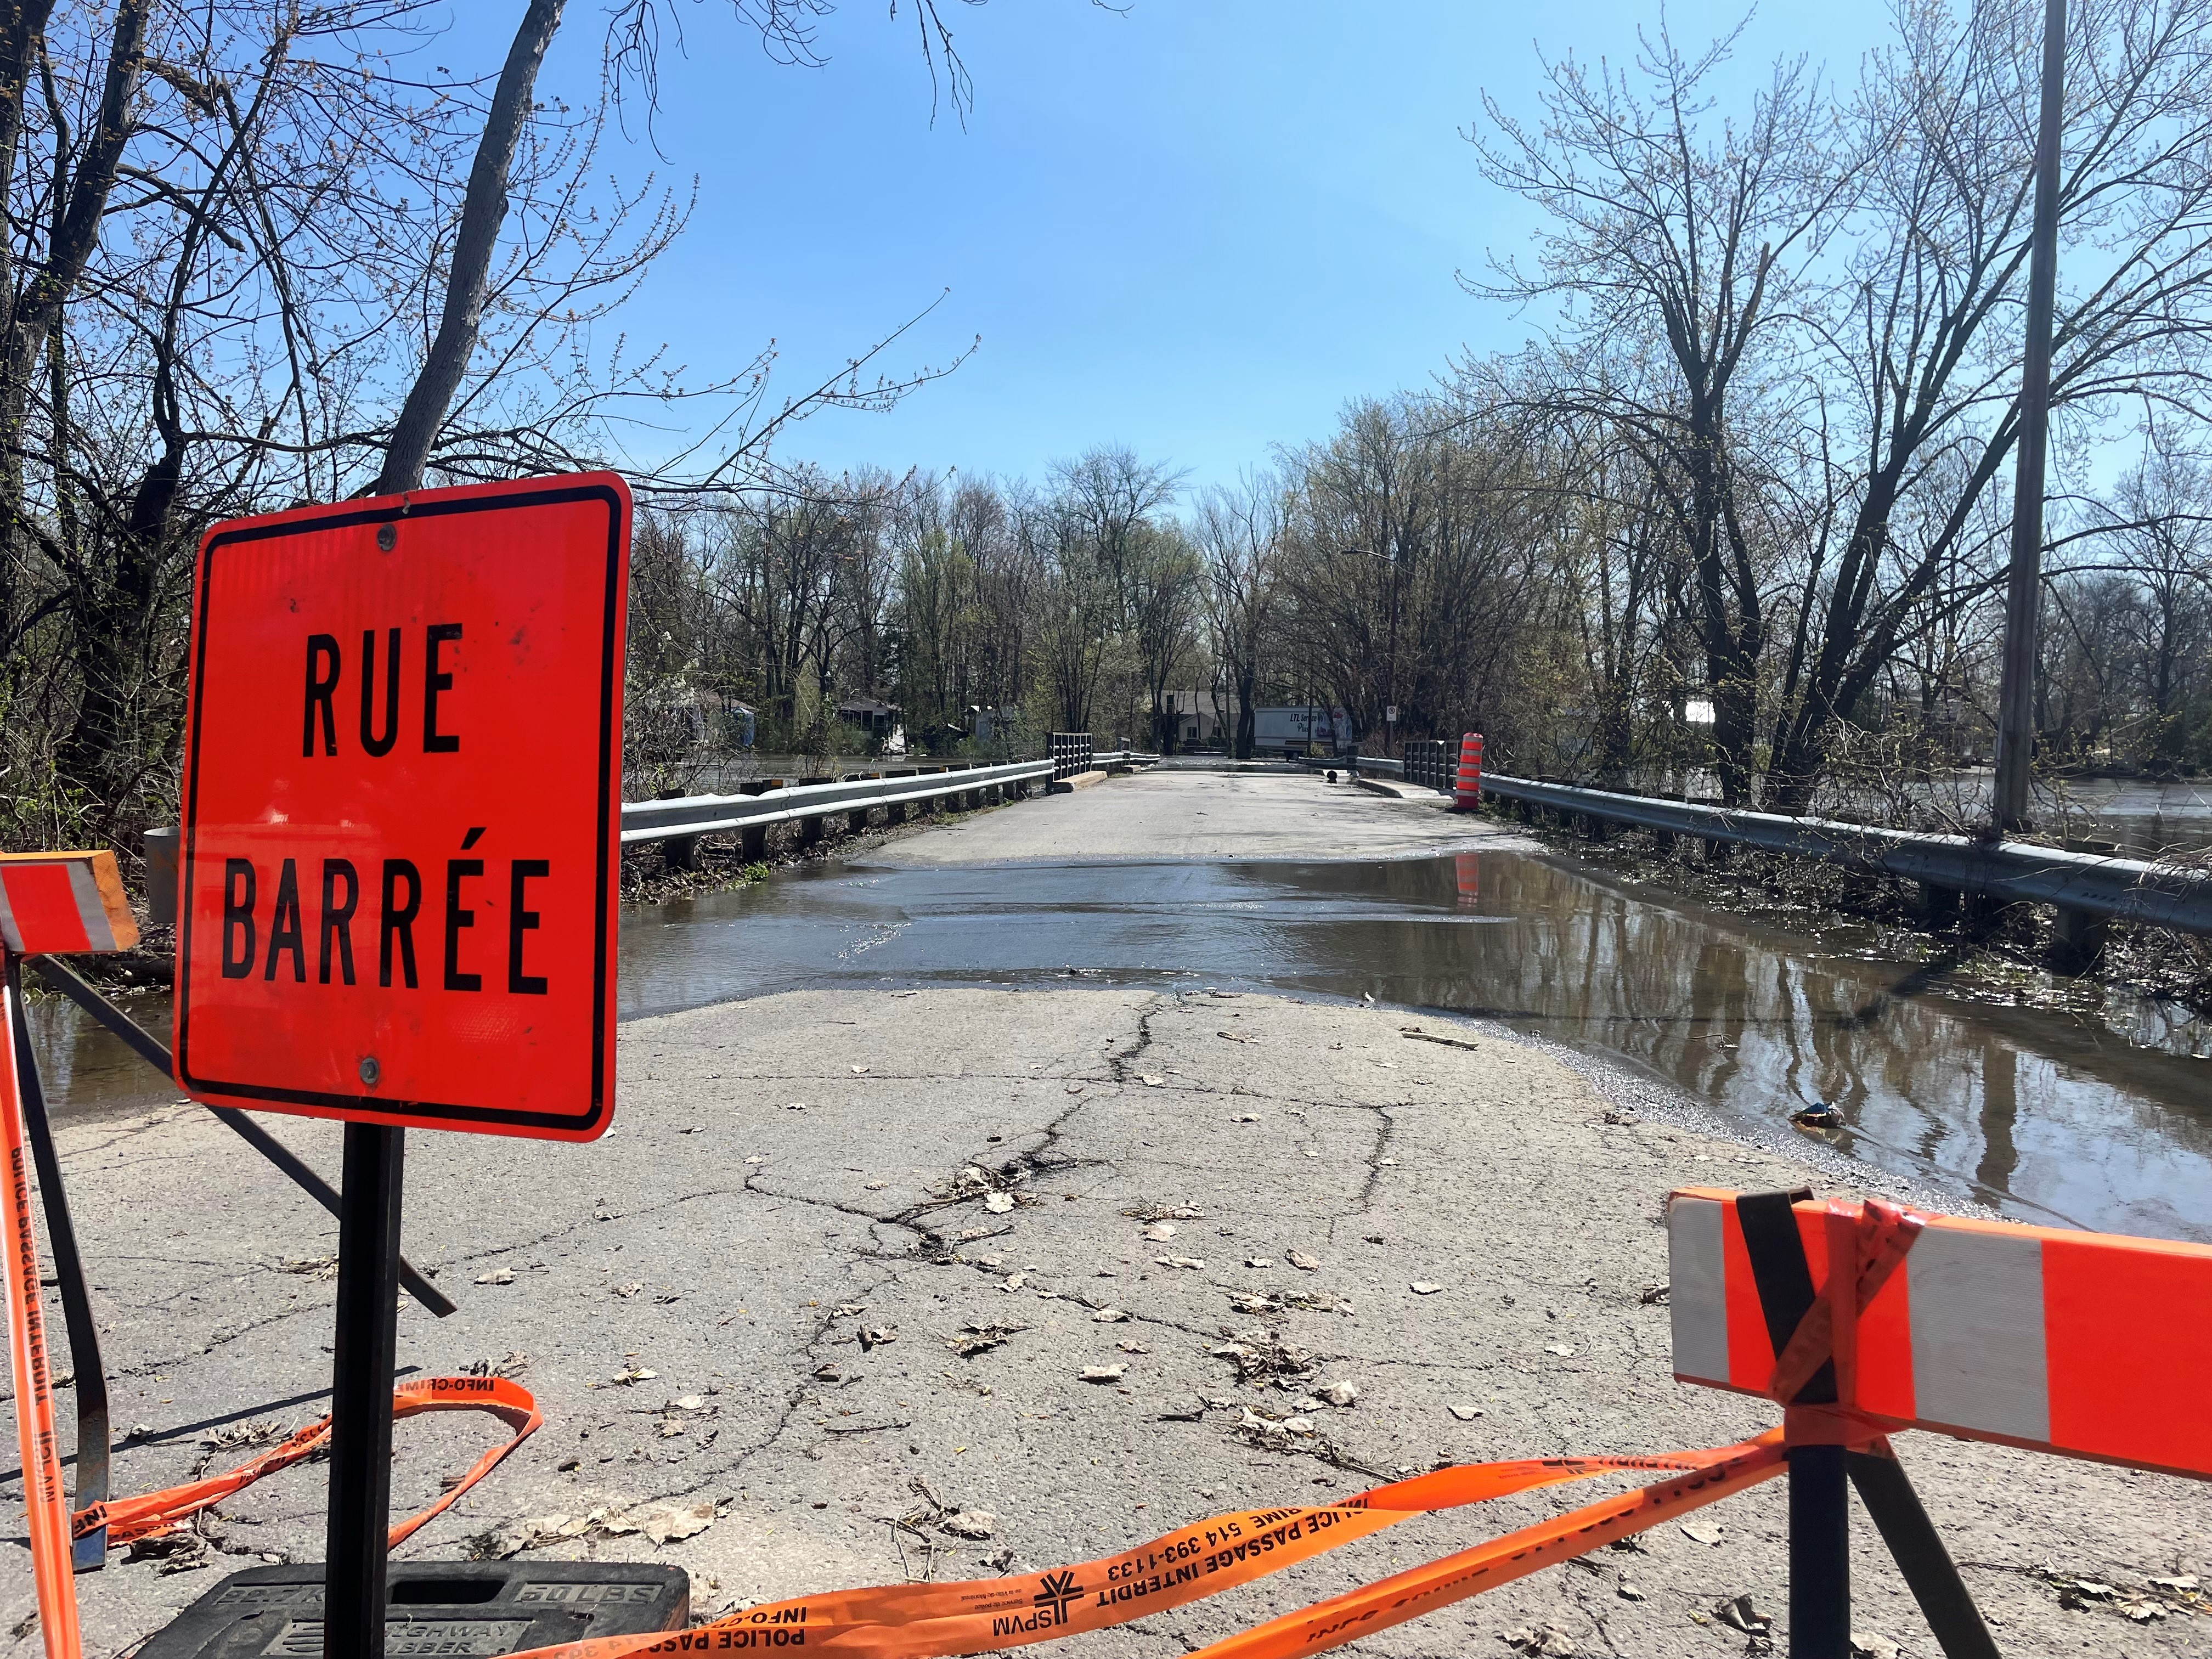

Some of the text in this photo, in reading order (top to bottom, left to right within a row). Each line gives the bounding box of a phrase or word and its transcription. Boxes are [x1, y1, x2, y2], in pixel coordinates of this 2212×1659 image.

[303, 623, 462, 757] RUE
[222, 827, 550, 995] BARRÉE
[1205, 1525, 1302, 1574] PASSAGE
[1206, 1522, 1241, 1547] 514
[1108, 1537, 1200, 1581] 393-1133
[1097, 1565, 1199, 1607] INTERDIT
[386, 1625, 506, 1637] IGHWAY
[718, 1629, 804, 1649] POLICE
[993, 1610, 1052, 1637] SPVM
[386, 1641, 472, 1654] UBBER
